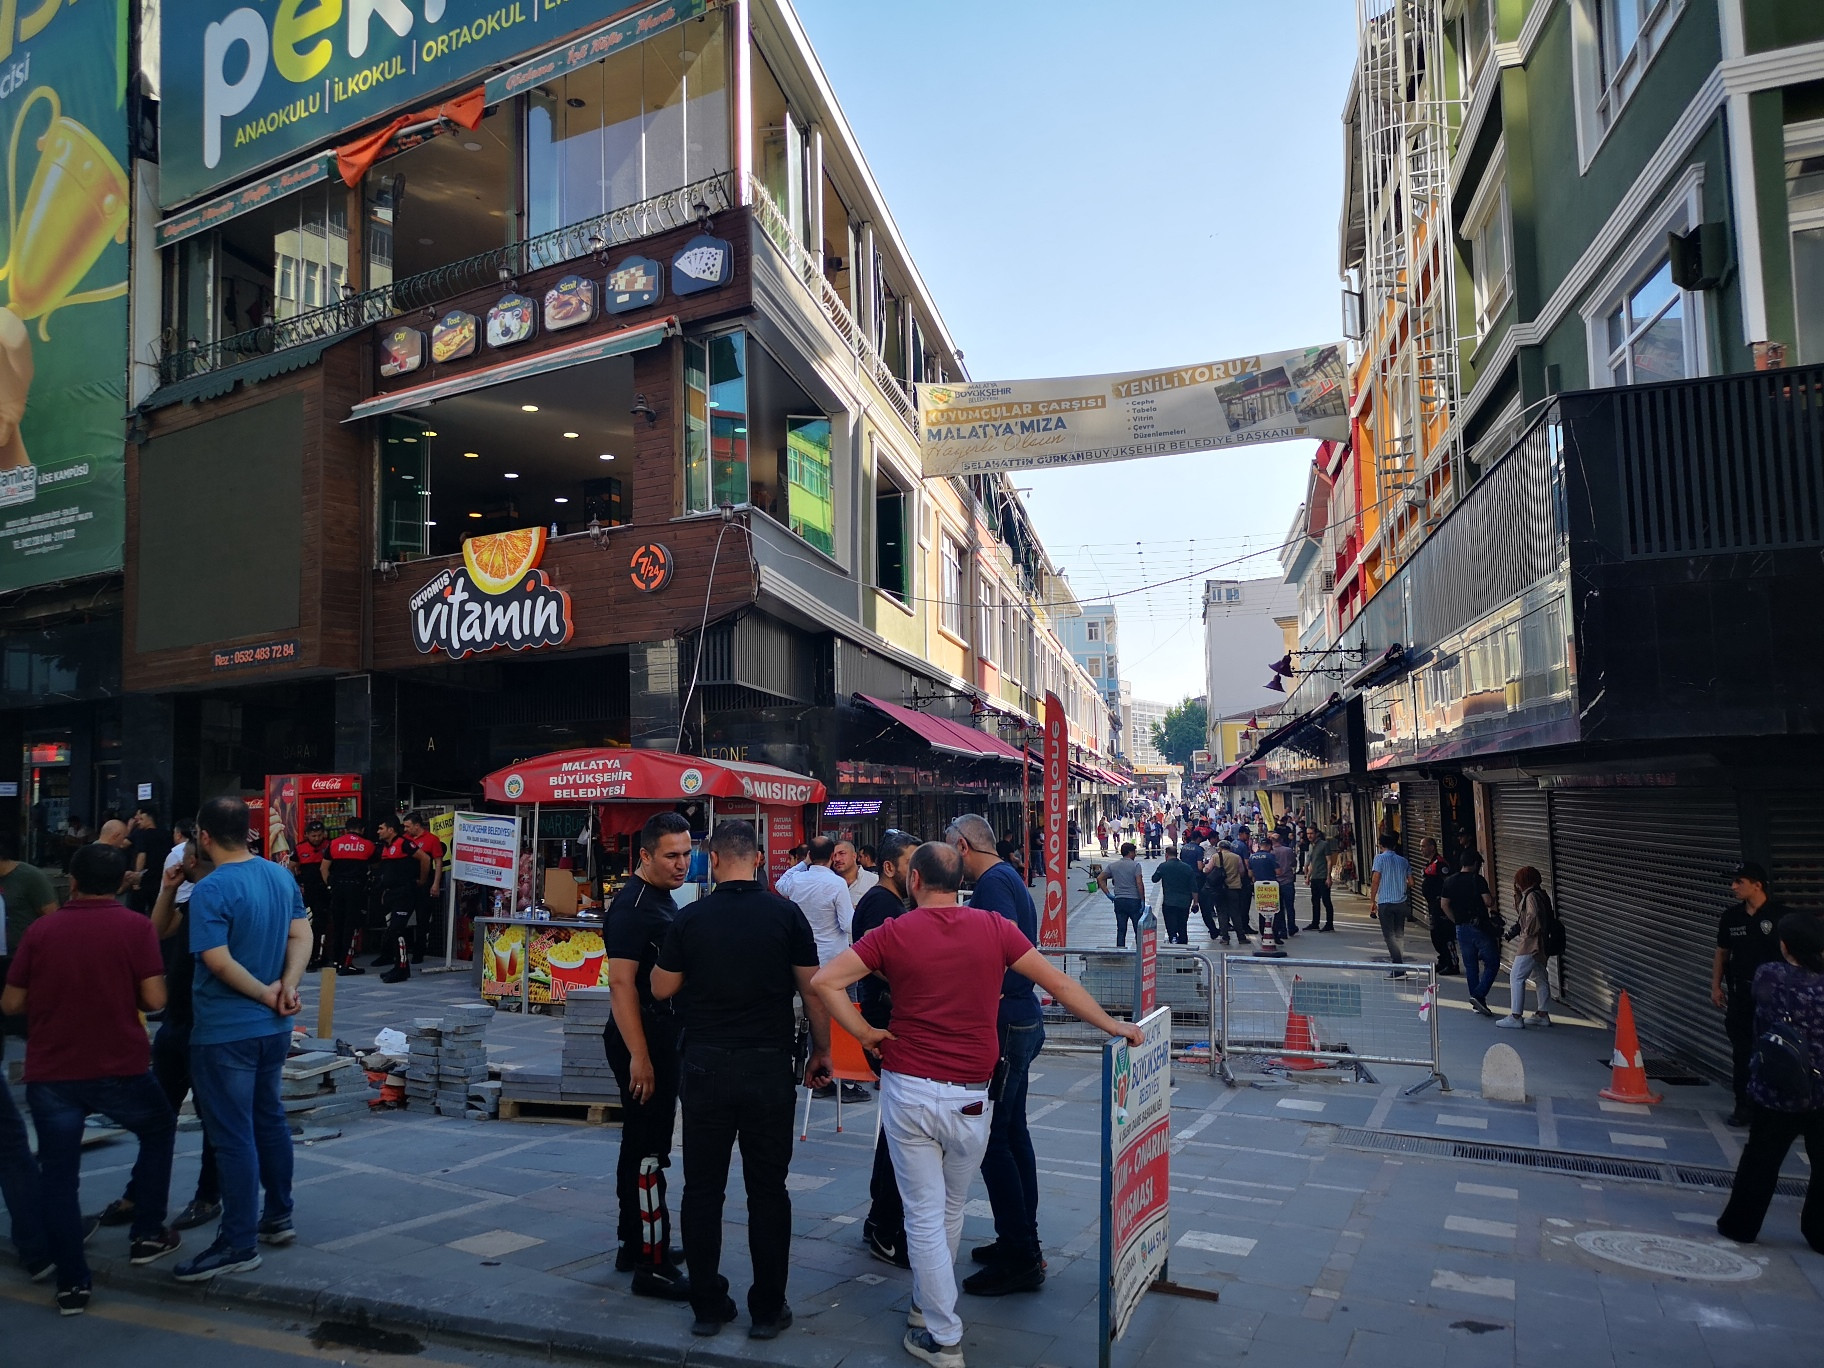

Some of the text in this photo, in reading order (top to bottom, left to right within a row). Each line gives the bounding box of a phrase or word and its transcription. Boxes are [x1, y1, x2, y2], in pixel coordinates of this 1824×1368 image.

[234, 92, 320, 147] ANAOKULU
[333, 55, 406, 103] İLKOKUL
[422, 7, 525, 62] ORTAOKUL
[559, 279, 577, 294] Simit
[447, 315, 461, 327] Tost
[394, 331, 406, 343] Çay
[968, 382, 998, 390] MALATYA
[927, 398, 1102, 424] KUYUMCULAR ÇARŞISI
[1131, 399, 1155, 407] Cephe
[927, 416, 1068, 442] MALATYA'MIZA
[1132, 423, 1155, 431] Çevre
[1133, 428, 1186, 440] Düzenlemeleri
[1236, 428, 1294, 442] BAŞKANI
[1003, 430, 1066, 452] Olsun
[54, 463, 89, 481] KAMPÜSÜ
[638, 555, 661, 580] 7/24
[411, 573, 450, 610] OKYANUS
[417, 577, 559, 649] vitamin
[234, 649, 254, 664] 0532
[254, 647, 270, 661] 483
[271, 645, 282, 658] 72
[283, 643, 294, 656] 84
[702, 746, 749, 761] AFONE
[561, 759, 621, 772] MALATYA
[550, 769, 632, 786] BÜYÜKŞEHİR
[554, 783, 625, 799] BELEDİYESİ
[338, 841, 365, 852] POLİS
[1131, 1040, 1169, 1090] BÜYÜKŞEHİR
[1134, 1127, 1169, 1175] ONARIM
[1116, 1176, 1154, 1246] ÇALIŞMASI
